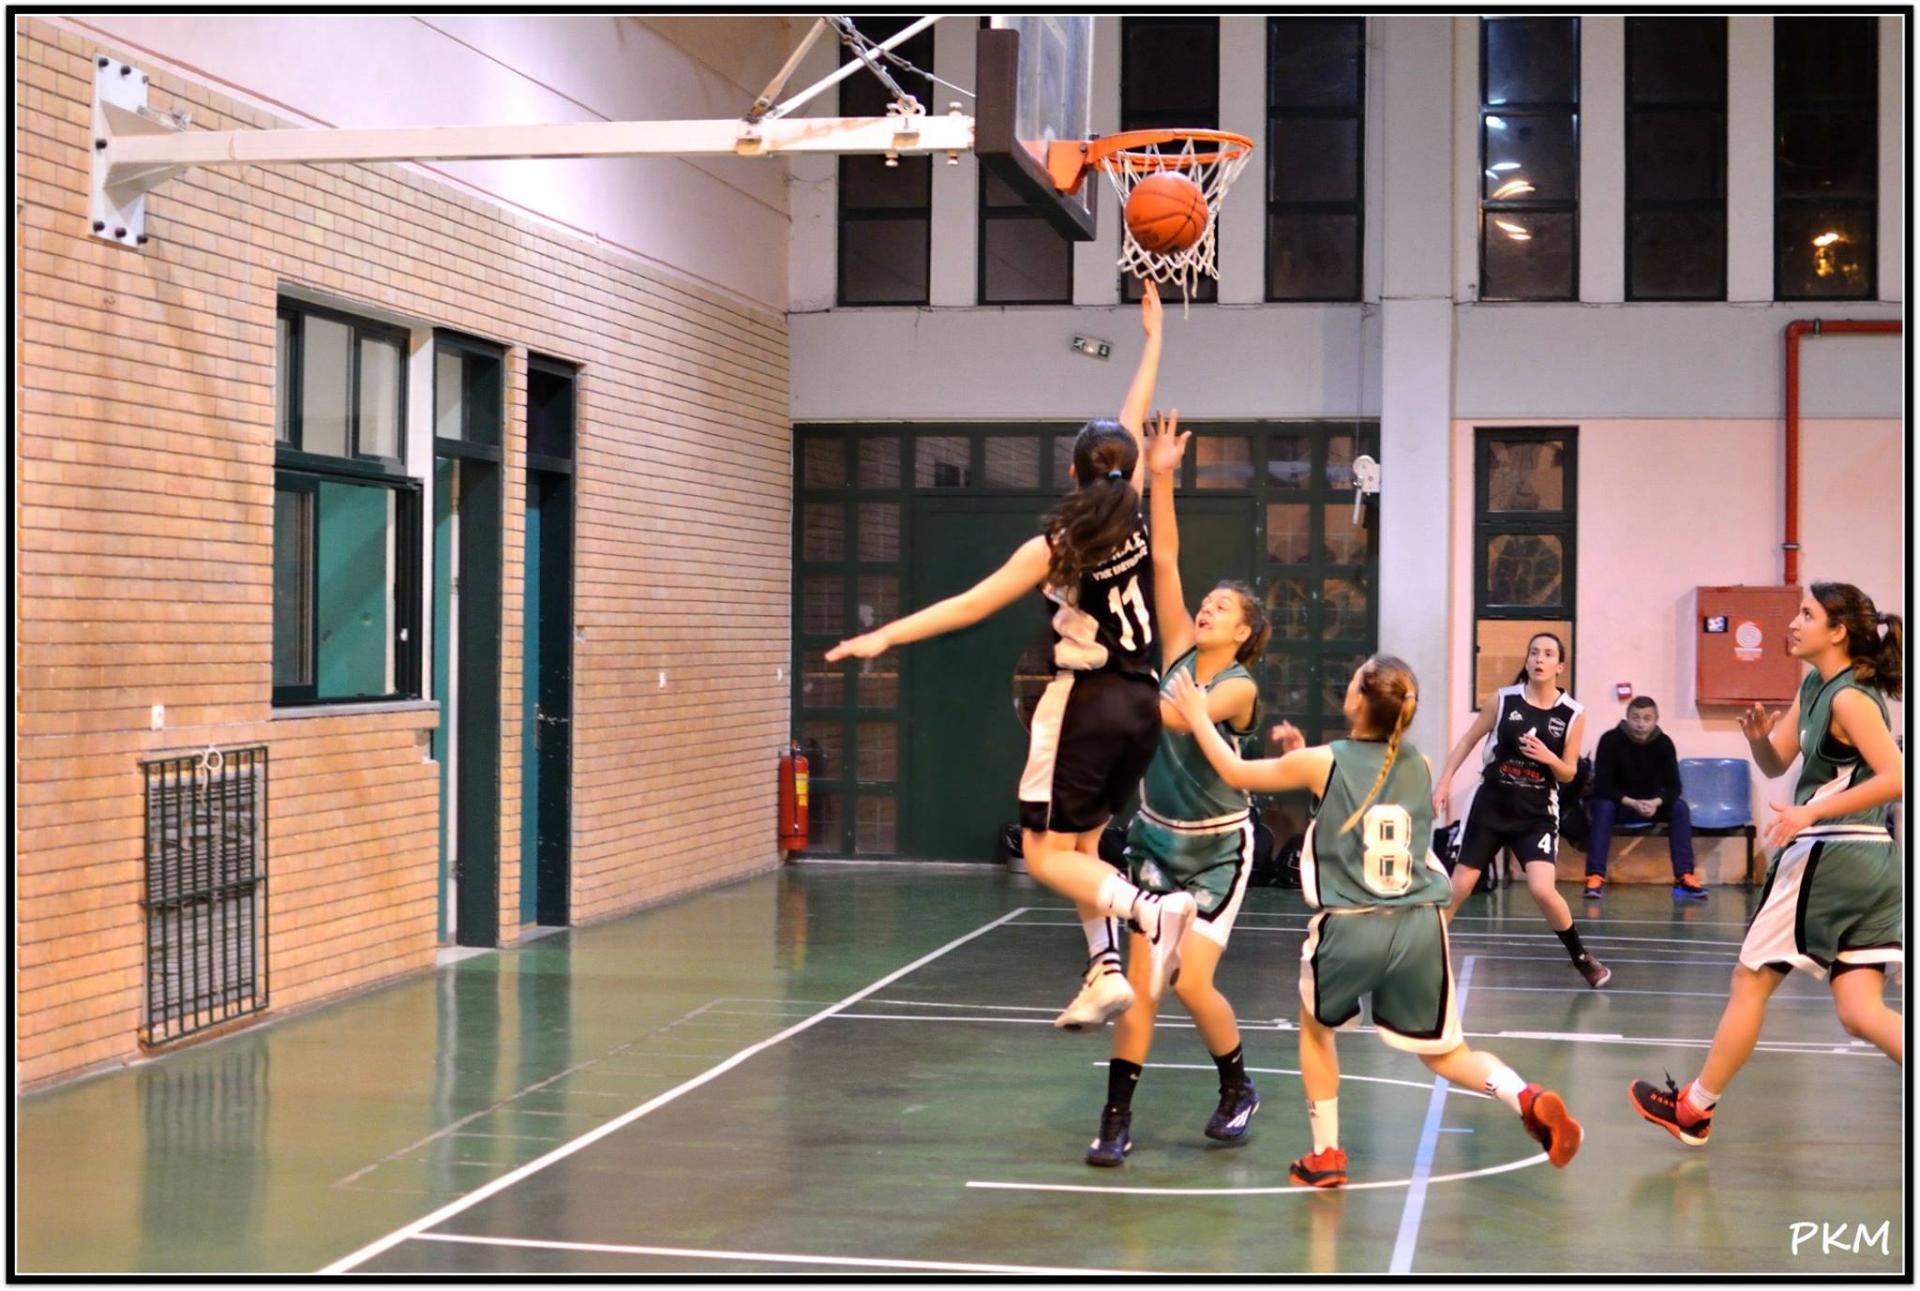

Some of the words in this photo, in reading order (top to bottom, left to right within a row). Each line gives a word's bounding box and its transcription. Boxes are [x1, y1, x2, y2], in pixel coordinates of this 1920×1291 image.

[1108, 575, 1152, 651] 11
[1363, 804, 1412, 895] 8
[1537, 832, 1552, 855] 4
